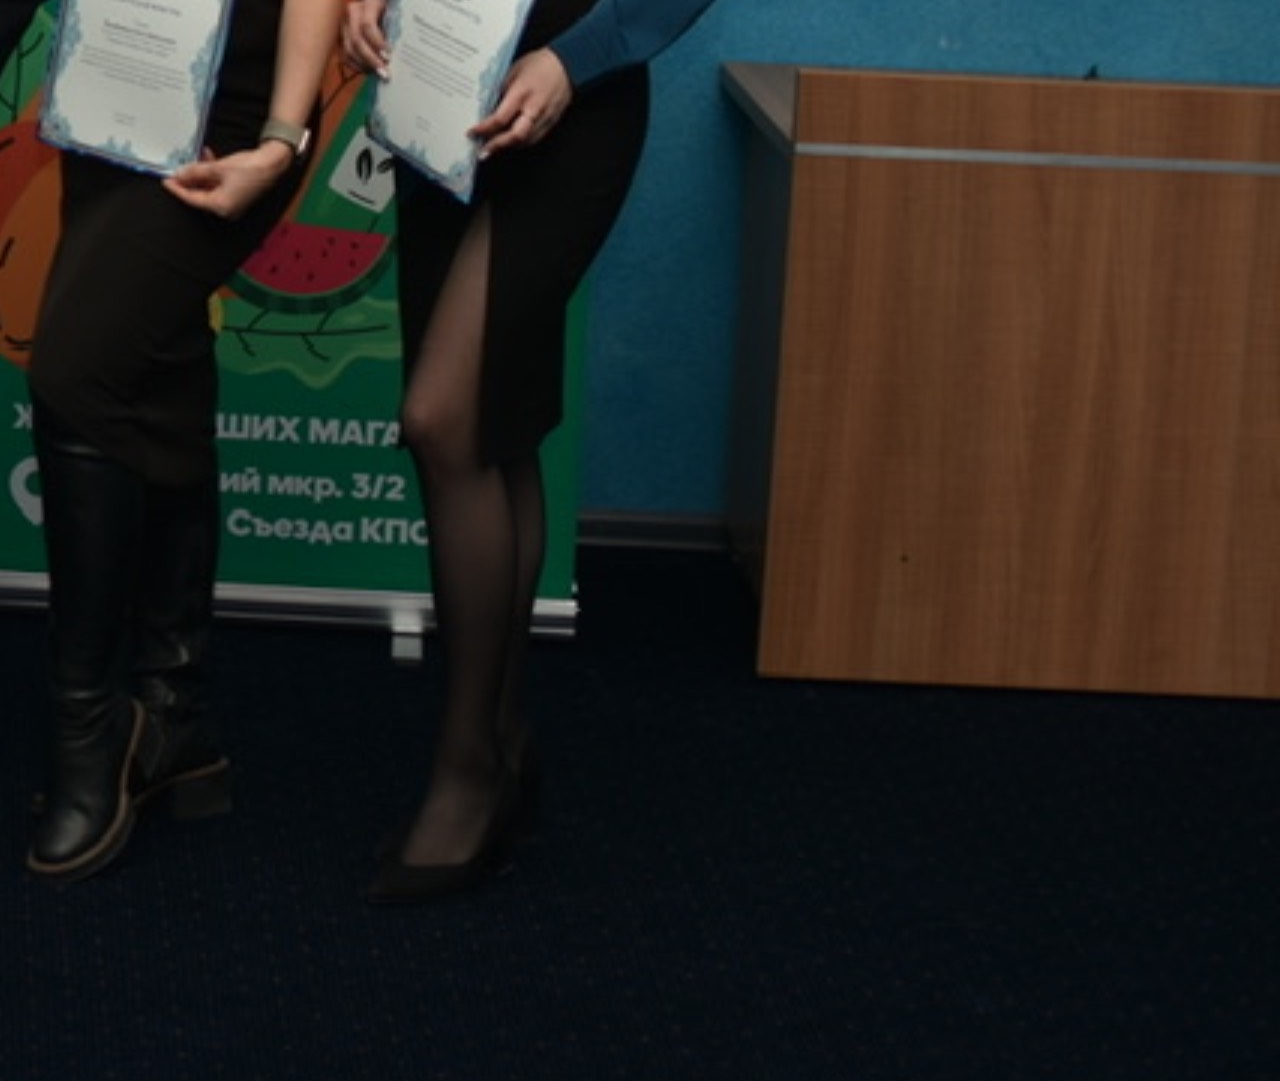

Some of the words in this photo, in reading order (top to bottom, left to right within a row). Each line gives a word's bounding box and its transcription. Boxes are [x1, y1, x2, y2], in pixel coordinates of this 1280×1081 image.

[216, 413, 301, 444] ШИХ
[267, 474, 344, 503] мкр.
[351, 472, 406, 502] 3/2
[226, 508, 354, 545] Съезда
[359, 517, 430, 546] КПС
